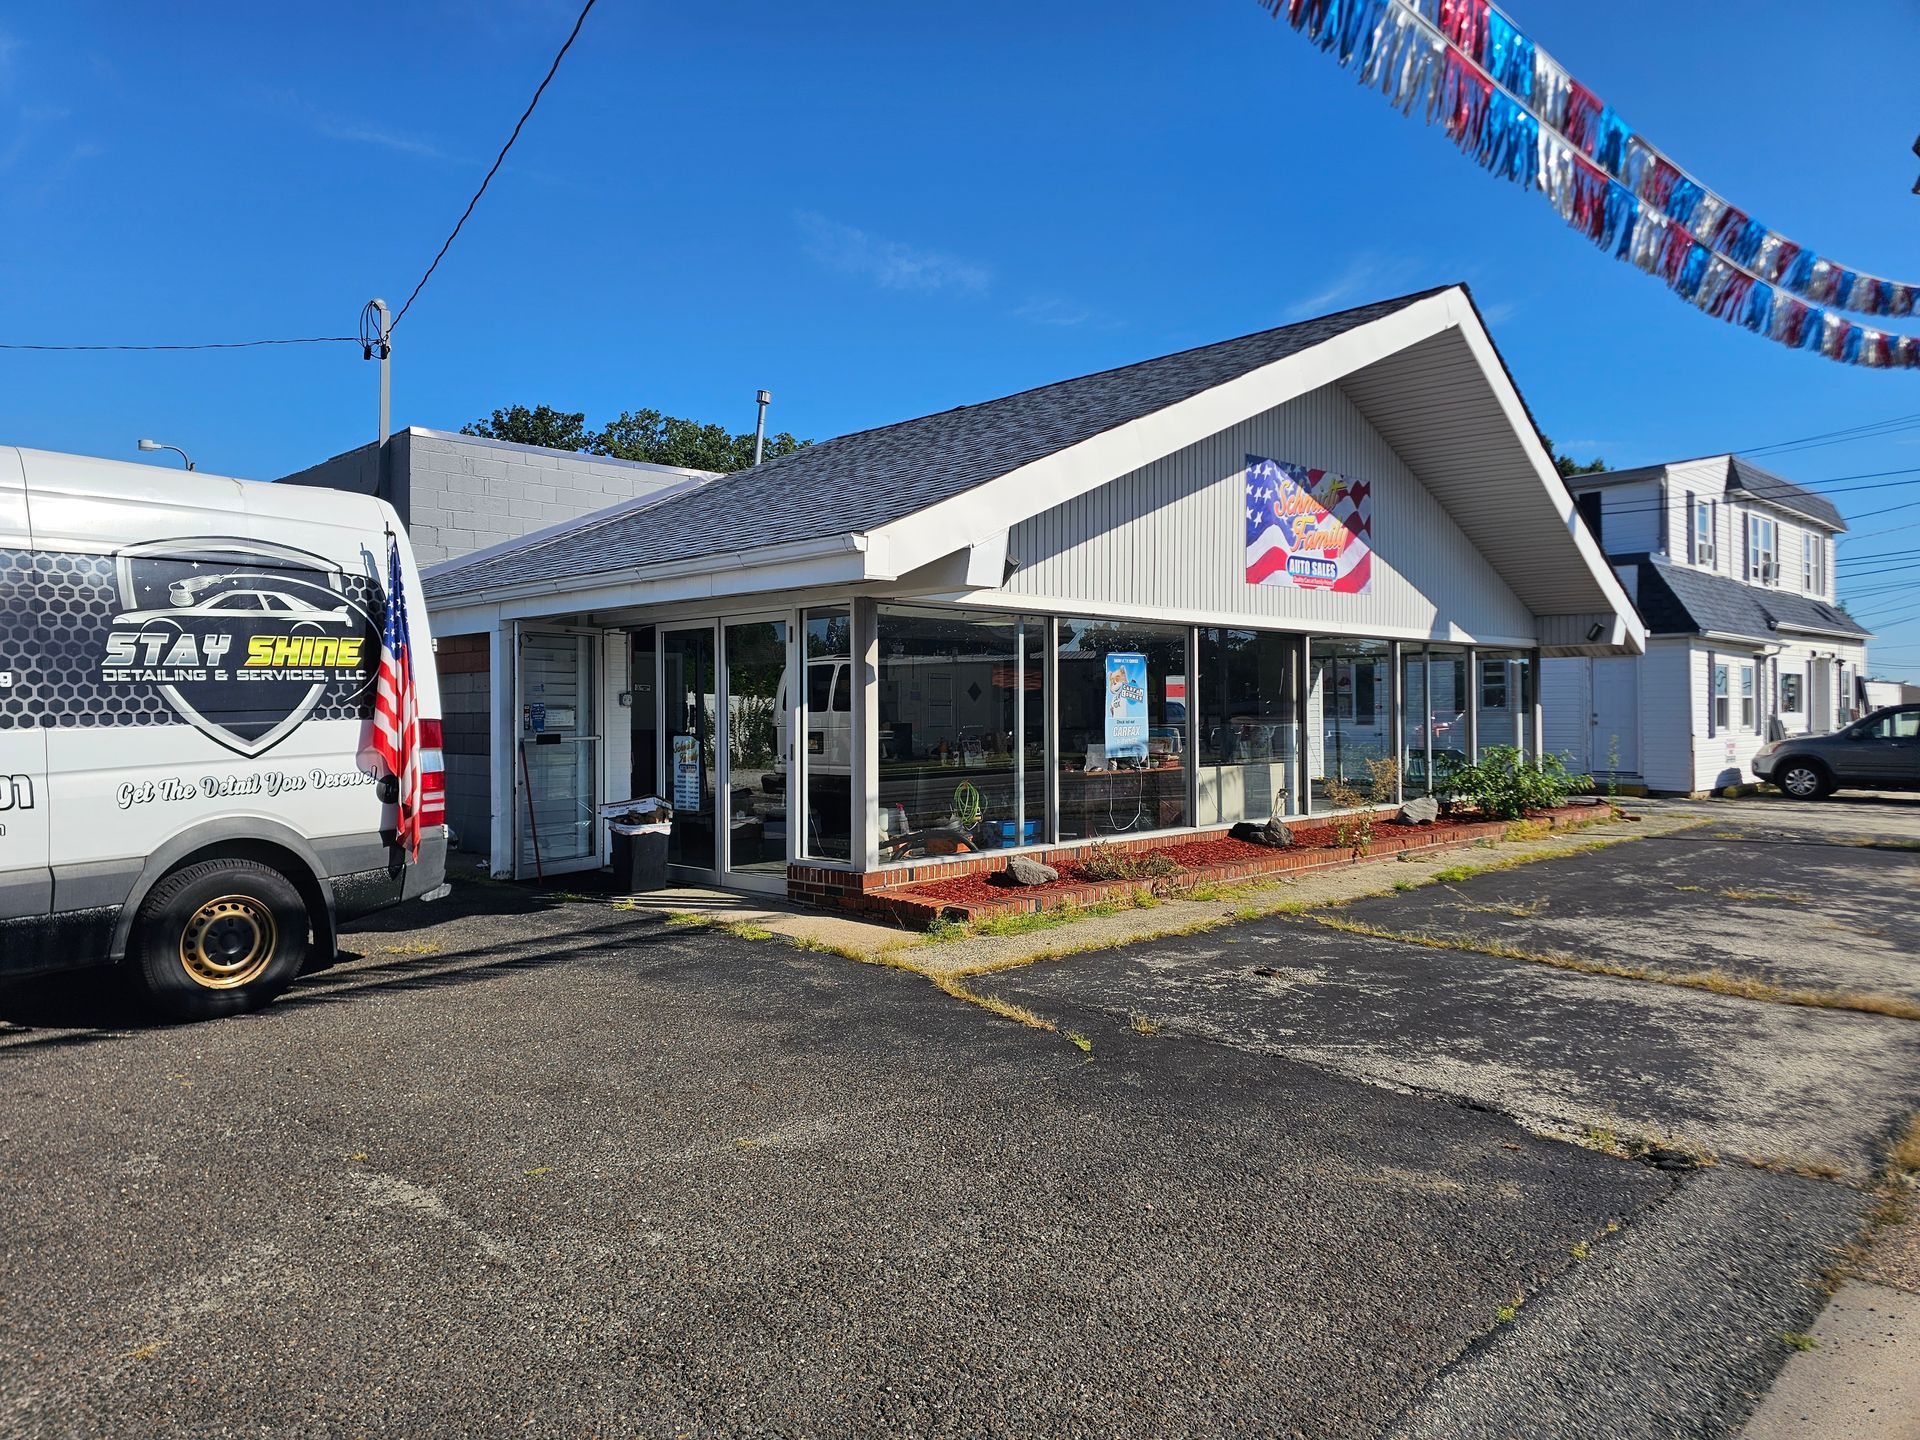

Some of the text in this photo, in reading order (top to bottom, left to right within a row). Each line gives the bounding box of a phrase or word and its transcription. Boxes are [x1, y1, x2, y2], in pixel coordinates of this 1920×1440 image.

[1289, 515, 1349, 558] Family
[1289, 558, 1336, 578] AUTO SALES
[102, 632, 365, 667] STAY SHINE
[102, 669, 367, 683] DETAILING & SERVICES, LLC
[1113, 725, 1141, 737] CARFAX
[116, 765, 378, 809] Get The Detail You Deserve!
